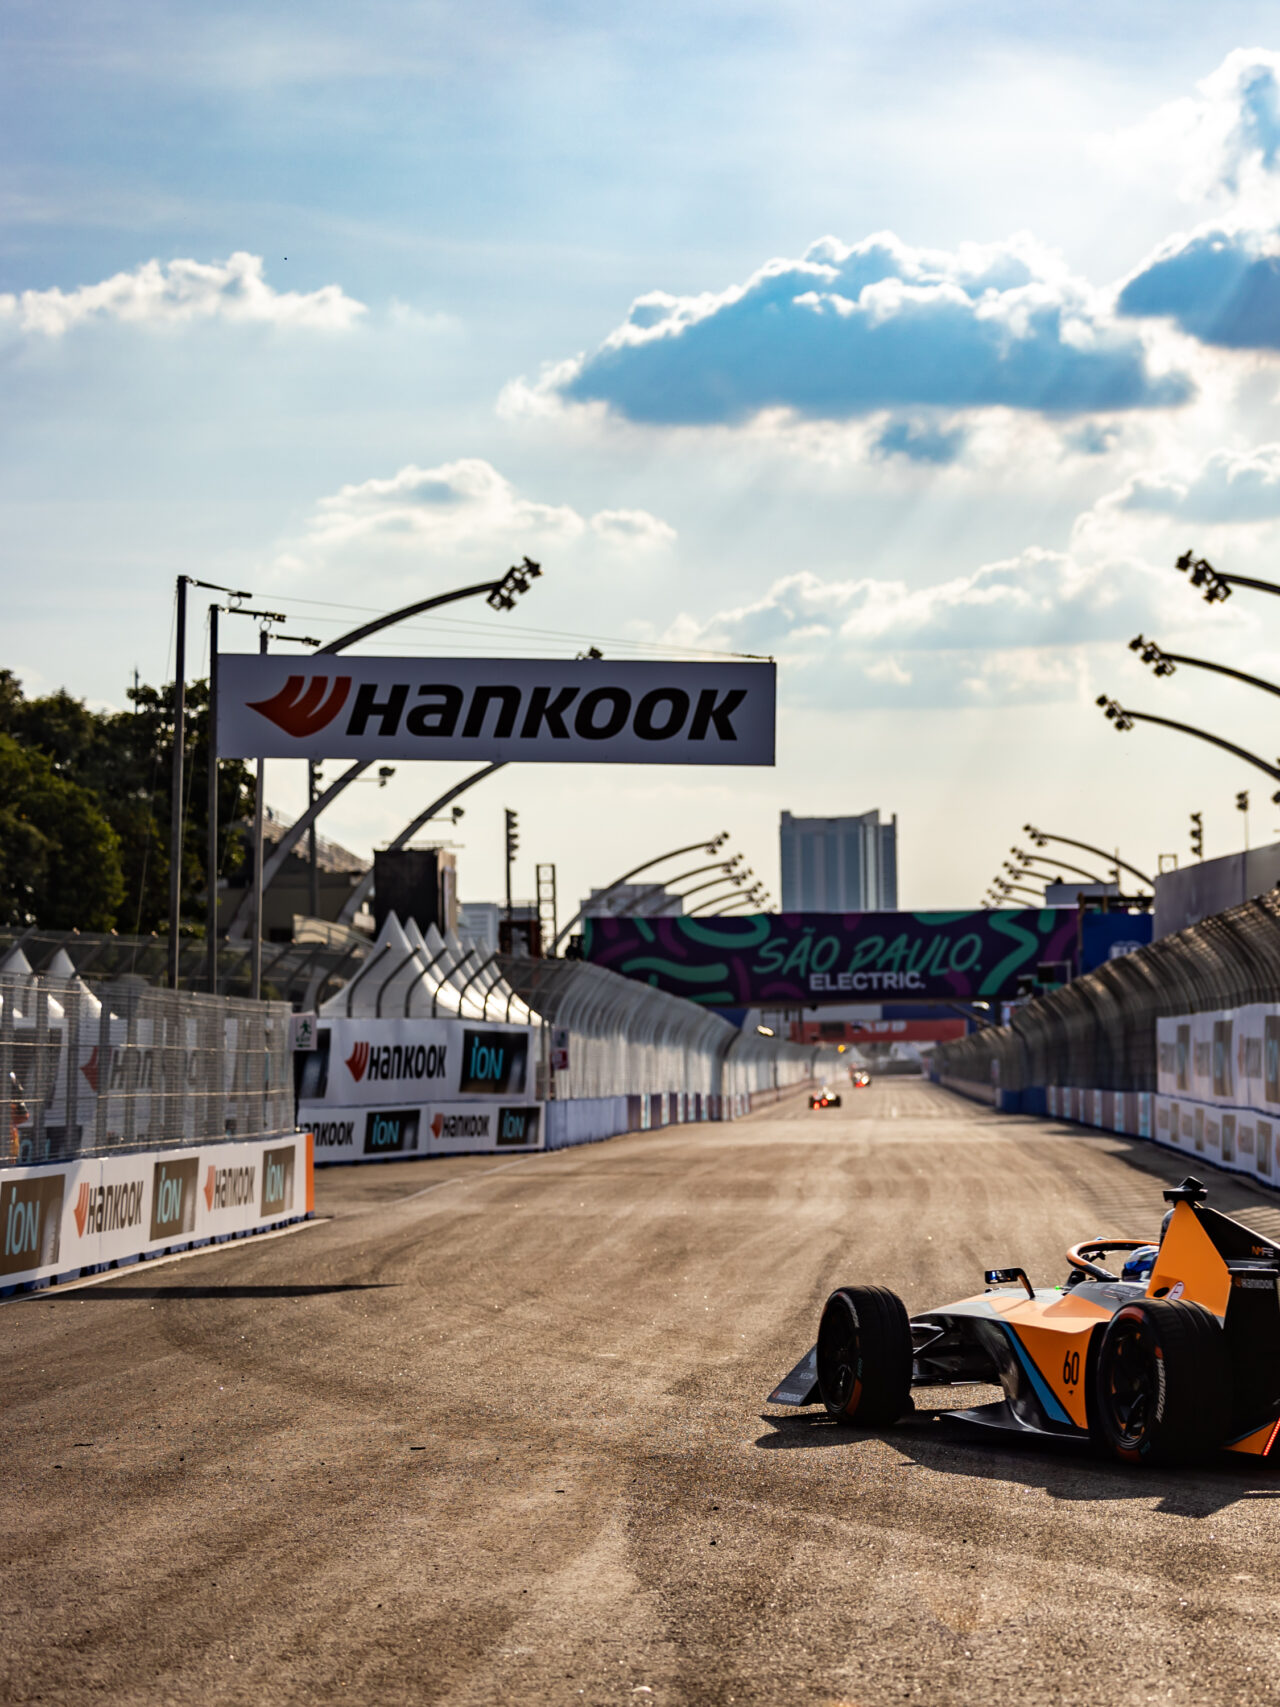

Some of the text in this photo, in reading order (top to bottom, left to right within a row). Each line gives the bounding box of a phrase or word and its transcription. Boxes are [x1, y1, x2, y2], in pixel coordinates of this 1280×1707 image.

[752, 927, 840, 978] SÃO
[809, 971, 926, 991] ELECTRIC.
[1063, 1350, 1080, 1386] 60
